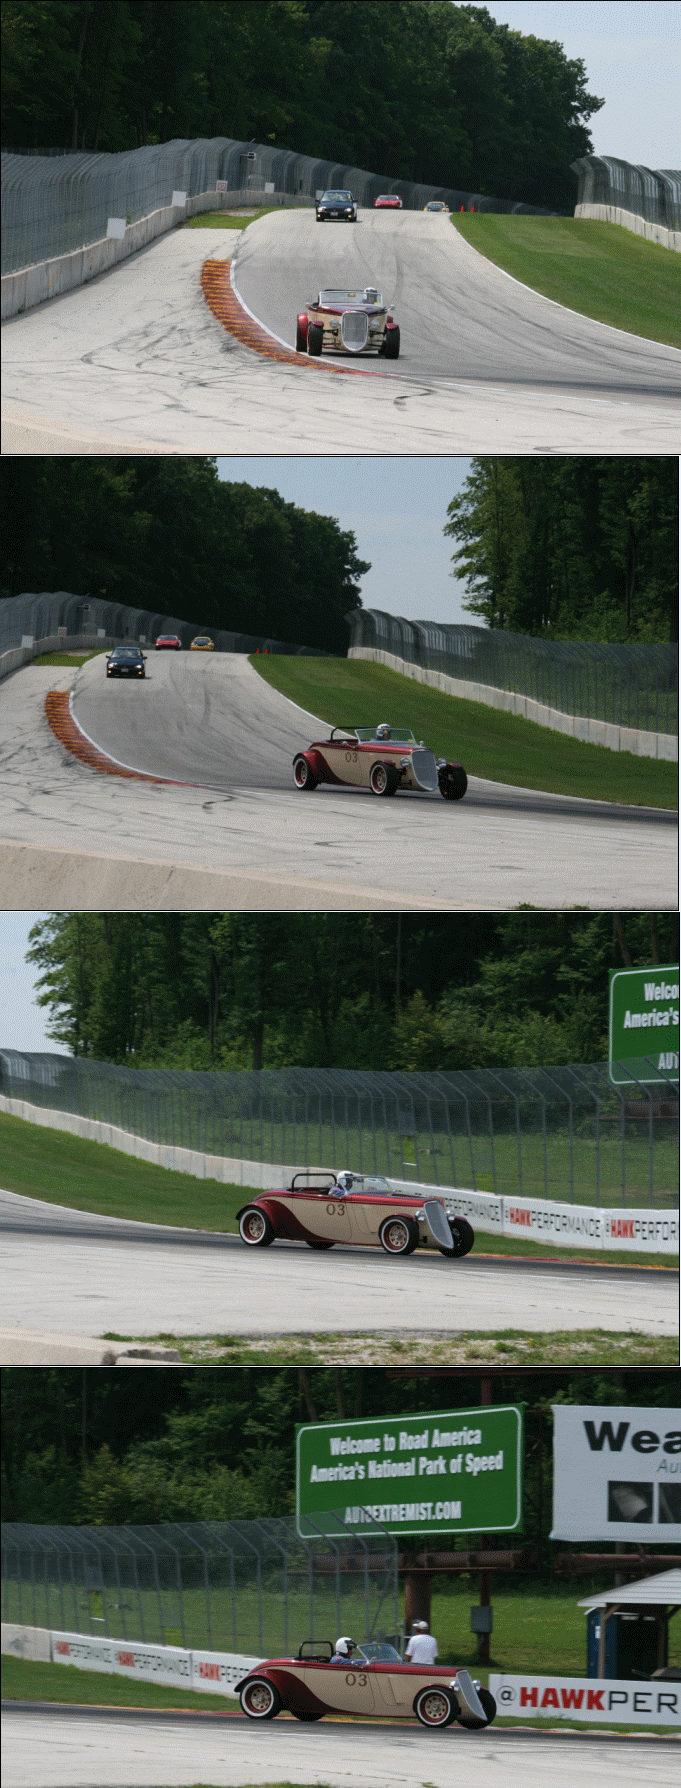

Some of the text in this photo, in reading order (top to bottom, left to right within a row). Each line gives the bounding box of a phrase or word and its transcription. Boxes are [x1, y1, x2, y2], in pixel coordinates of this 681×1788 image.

[345, 752, 358, 763] 03
[623, 1007, 679, 1029] America's
[326, 1203, 345, 1216] 03
[329, 1426, 482, 1456] Welcome to Road America
[583, 1420, 681, 1454] Wea
[310, 1450, 504, 1483] America's National Park of Speed
[344, 1500, 462, 1524] AUTOEXTREMIST.COM
[345, 1673, 368, 1686] 03
